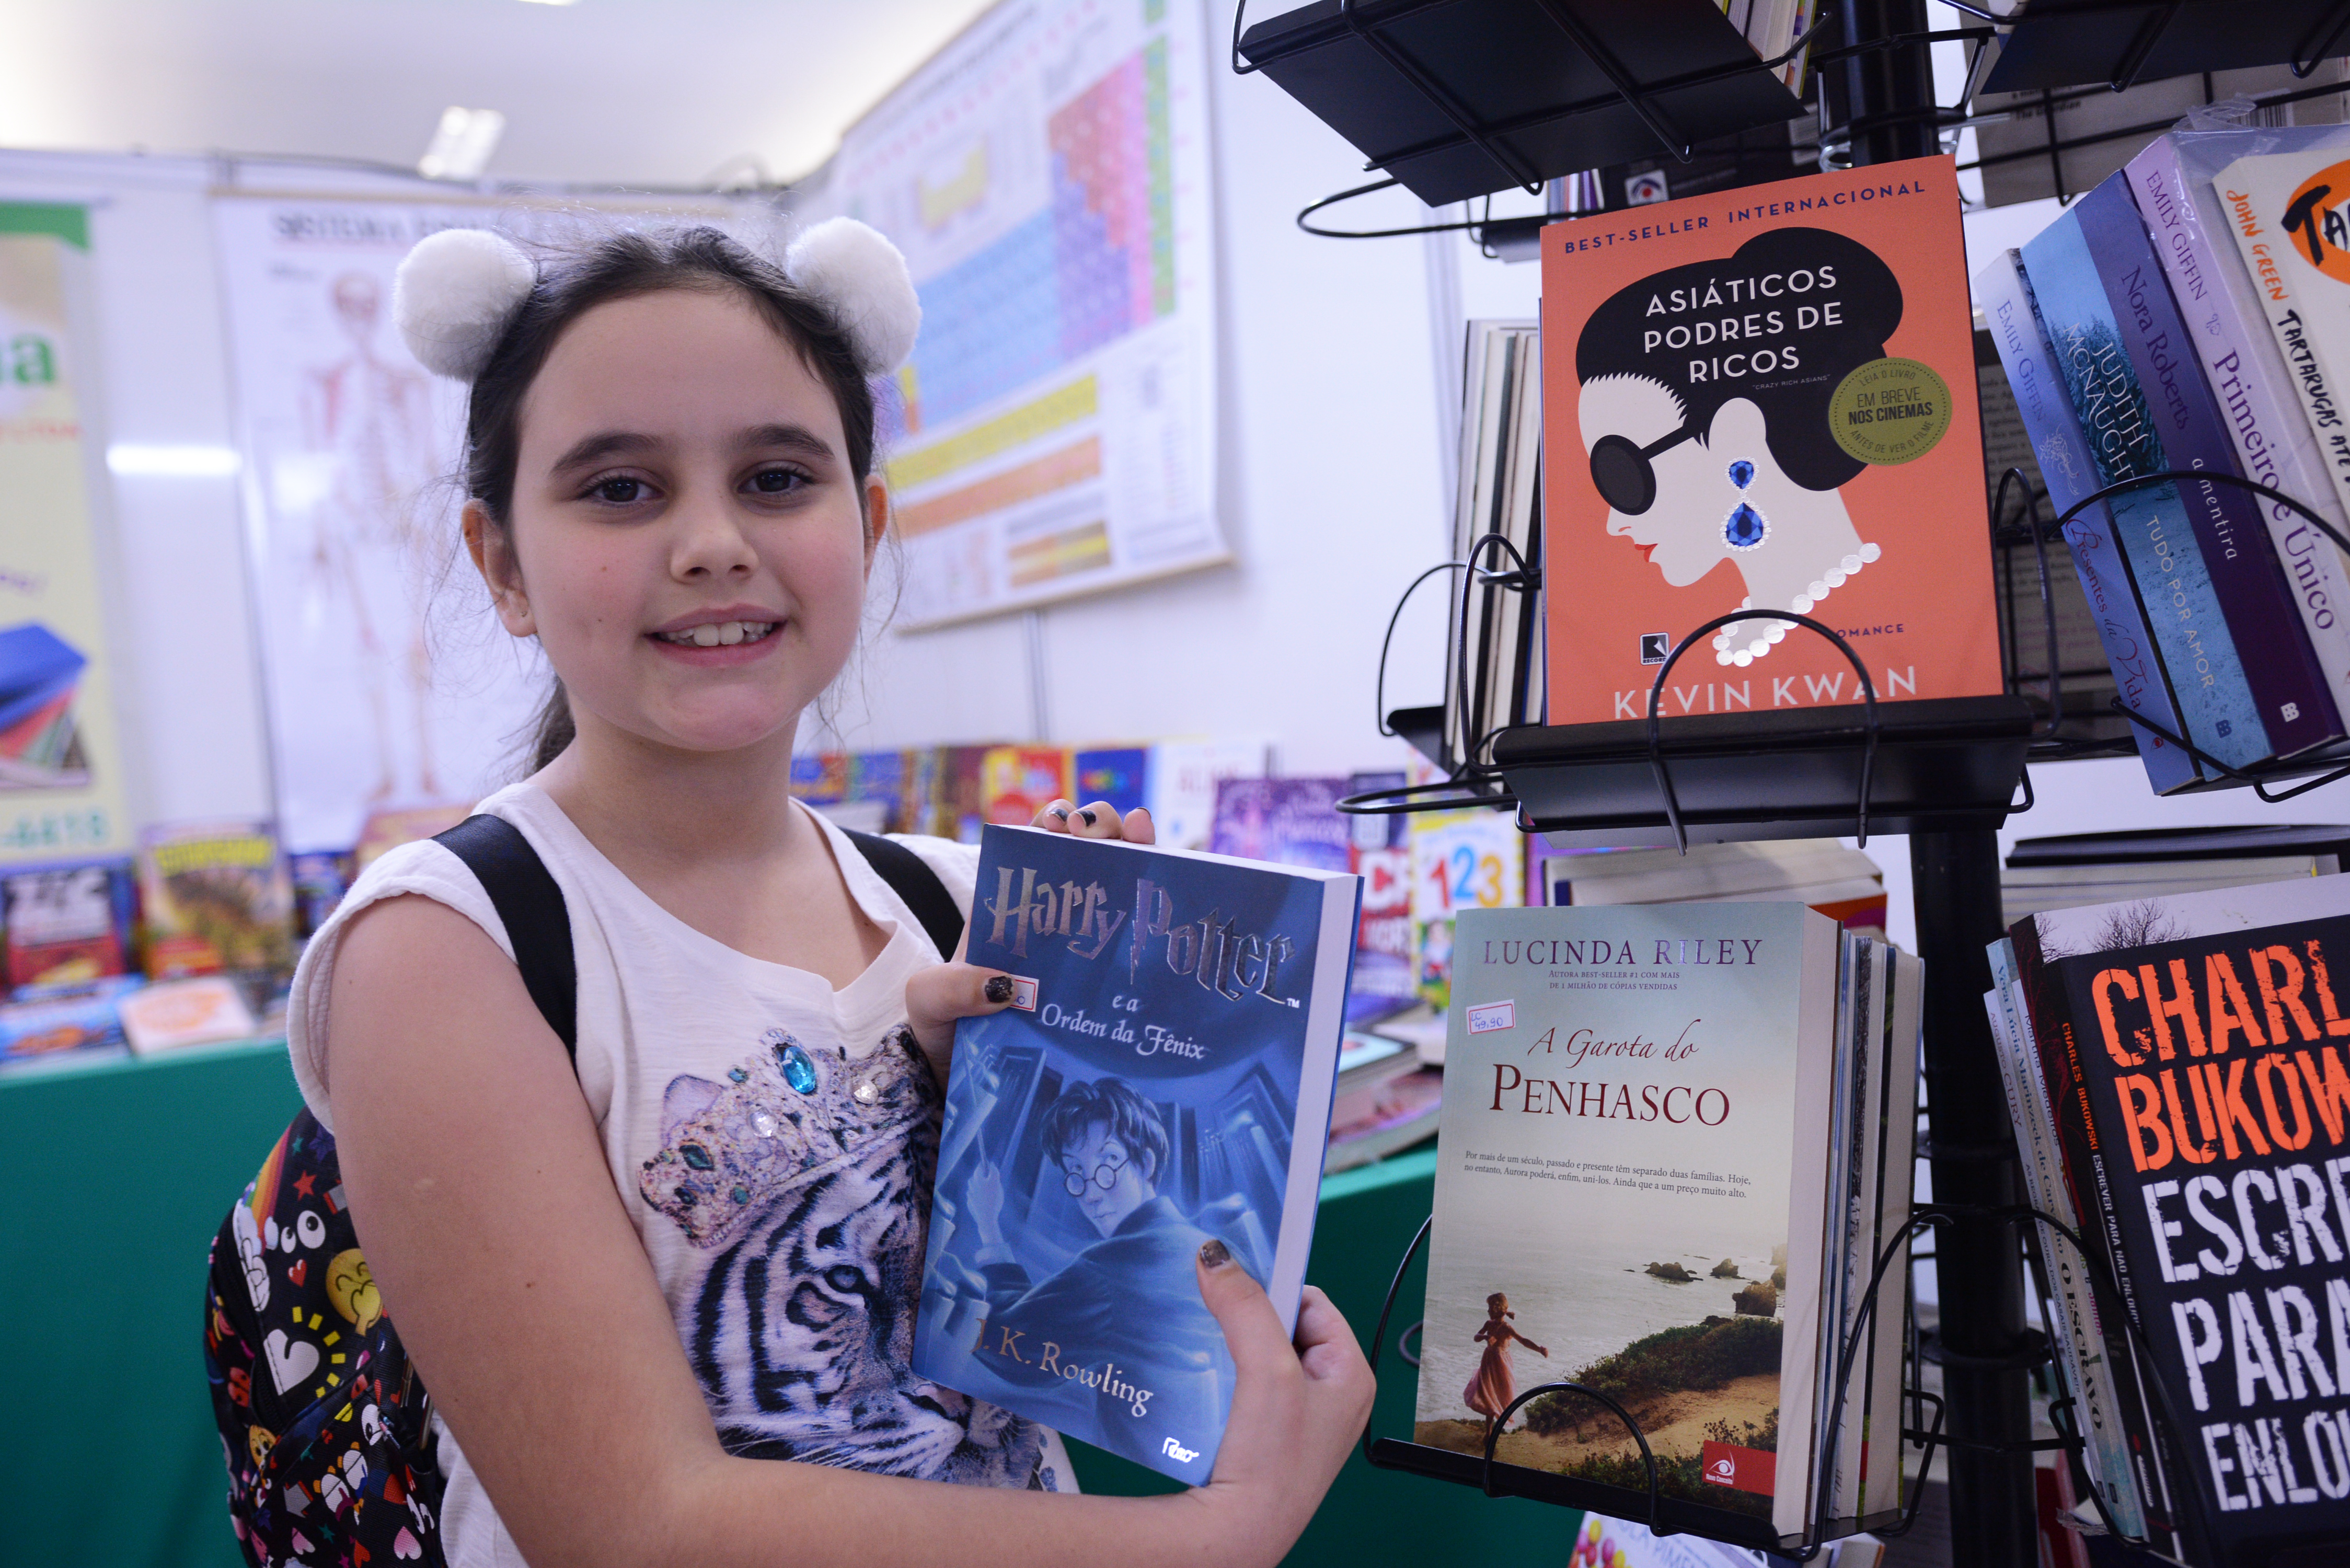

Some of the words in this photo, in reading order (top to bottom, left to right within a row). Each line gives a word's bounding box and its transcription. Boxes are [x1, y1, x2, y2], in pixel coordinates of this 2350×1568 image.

[1565, 216, 1710, 254] BEST-SELLER
[1729, 181, 1926, 224] INTERNACIONAL
[2147, 169, 2181, 229] EMILY
[2172, 232, 2207, 302] GIFFIN
[2227, 190, 2264, 237] JOHN
[2252, 243, 2290, 301] GREEN
[2281, 185, 2350, 267] TA
[1644, 311, 1784, 353] PODRES
[1798, 302, 1844, 330] DE
[1646, 266, 1837, 317] ASIÁTICOS
[1689, 346, 1800, 383] RICOS
[1860, 372, 1879, 386] LEIA
[1891, 370, 1916, 381] LIVRO
[1997, 299, 2023, 354] EMILY
[2019, 358, 2046, 422] GIFFIN
[2122, 266, 2154, 333] Nora
[2147, 332, 2187, 430] Roberts
[2277, 309, 2343, 428] TARTARUGAS
[1848, 410, 1873, 425] NOS
[1876, 402, 1933, 421] CINEMAS
[1857, 393, 1875, 408] EM
[1882, 387, 1921, 405] BREVE
[2064, 322, 2138, 480] MCNAUGH
[2091, 341, 2149, 447] JUDITH
[1850, 430, 1873, 451] ANTES
[1875, 444, 1886, 453] DE
[1890, 444, 1906, 453] VER
[1908, 440, 1914, 448] O
[1913, 420, 1934, 442] FILME
[2192, 458, 2204, 469] a
[2199, 479, 2238, 560] mentira
[2214, 347, 2280, 492] Primeiro
[2272, 502, 2293, 521] e
[2284, 524, 2335, 630] Único
[2066, 518, 2108, 613] Presentes
[2146, 515, 2174, 572] TUDO
[2168, 579, 2192, 622] POR
[2184, 629, 2215, 689] AMOR
[1835, 624, 1904, 639] OMANCE
[2104, 618, 2129, 640] da
[1615, 680, 1751, 720] KEVIN
[1773, 665, 1916, 706] KWAN
[2116, 637, 2149, 710] Vida
[983, 867, 1126, 960] Harry
[1130, 878, 1295, 1004] Potter
[1483, 940, 1636, 964] LUCINDA
[1653, 939, 1762, 965] RILEY
[1112, 995, 1122, 1009] e
[1126, 998, 1139, 1012] a
[1568, 981, 1596, 989] MILHÃO
[1610, 981, 1637, 990] CÓPIAS
[1996, 965, 2012, 1003] Vera
[1041, 1004, 1107, 1037] Ordem
[1111, 1020, 1134, 1043] da
[1136, 1024, 1205, 1059] Fênix
[1527, 1027, 1556, 1056] A
[1565, 1029, 1657, 1068] Garota
[1665, 1019, 1701, 1062] do
[2006, 1007, 2023, 1053] Lúcia
[1490, 1064, 1730, 1126] PENHASCO
[1989, 1012, 2008, 1069] AUGUSTO
[2002, 1072, 2022, 1128] CURY
[2016, 1057, 2043, 1147] Marinzeck
[1465, 1150, 1478, 1159] Por
[1497, 1154, 1506, 1162] de
[1520, 1156, 1545, 1166] século,
[1546, 1159, 1575, 1169] passado
[1582, 1162, 1614, 1172] presente
[1616, 1164, 1630, 1174] têm
[1632, 1168, 1667, 1177] separado
[1669, 1169, 1688, 1179] duas
[1690, 1171, 1725, 1183] famílias.
[1728, 1174, 1751, 1186] Hoje,
[2036, 1149, 2048, 1171] de
[2060, 1022, 2083, 1083] CHARLES
[2076, 1087, 2099, 1151] BUKOWSKI
[2091, 1154, 2114, 1212] ESCREVER
[2105, 1214, 2121, 1246] PARA
[1474, 1165, 1502, 1175] entanto,
[1504, 1167, 1528, 1177] Aurora
[1529, 1170, 1556, 1181] poderá,
[1558, 1172, 1581, 1183] enfim,
[1583, 1175, 1611, 1185] uni-los.
[1613, 1177, 1637, 1189] Ainda
[1638, 1181, 1653, 1191] que
[1661, 1183, 1674, 1192] um
[1676, 1185, 1699, 1195] preço
[1701, 1187, 1726, 1197] muito
[1729, 1188, 1747, 1198] alto.
[2041, 1174, 2066, 1254] Carvho
[2028, 1178, 2040, 1210] REGRA
[2037, 1220, 2045, 1234] DE
[2041, 1236, 2053, 1267] OURO
[2048, 1269, 2058, 1291] DOS
[2054, 1293, 2067, 1332] CASAIS
[2063, 1333, 2082, 1393] SAUDÁVEIS
[1040, 1341, 1153, 1417] Rowling
[2059, 1262, 2072, 1285] O
[2066, 1291, 2103, 1430] ESCRAVO
